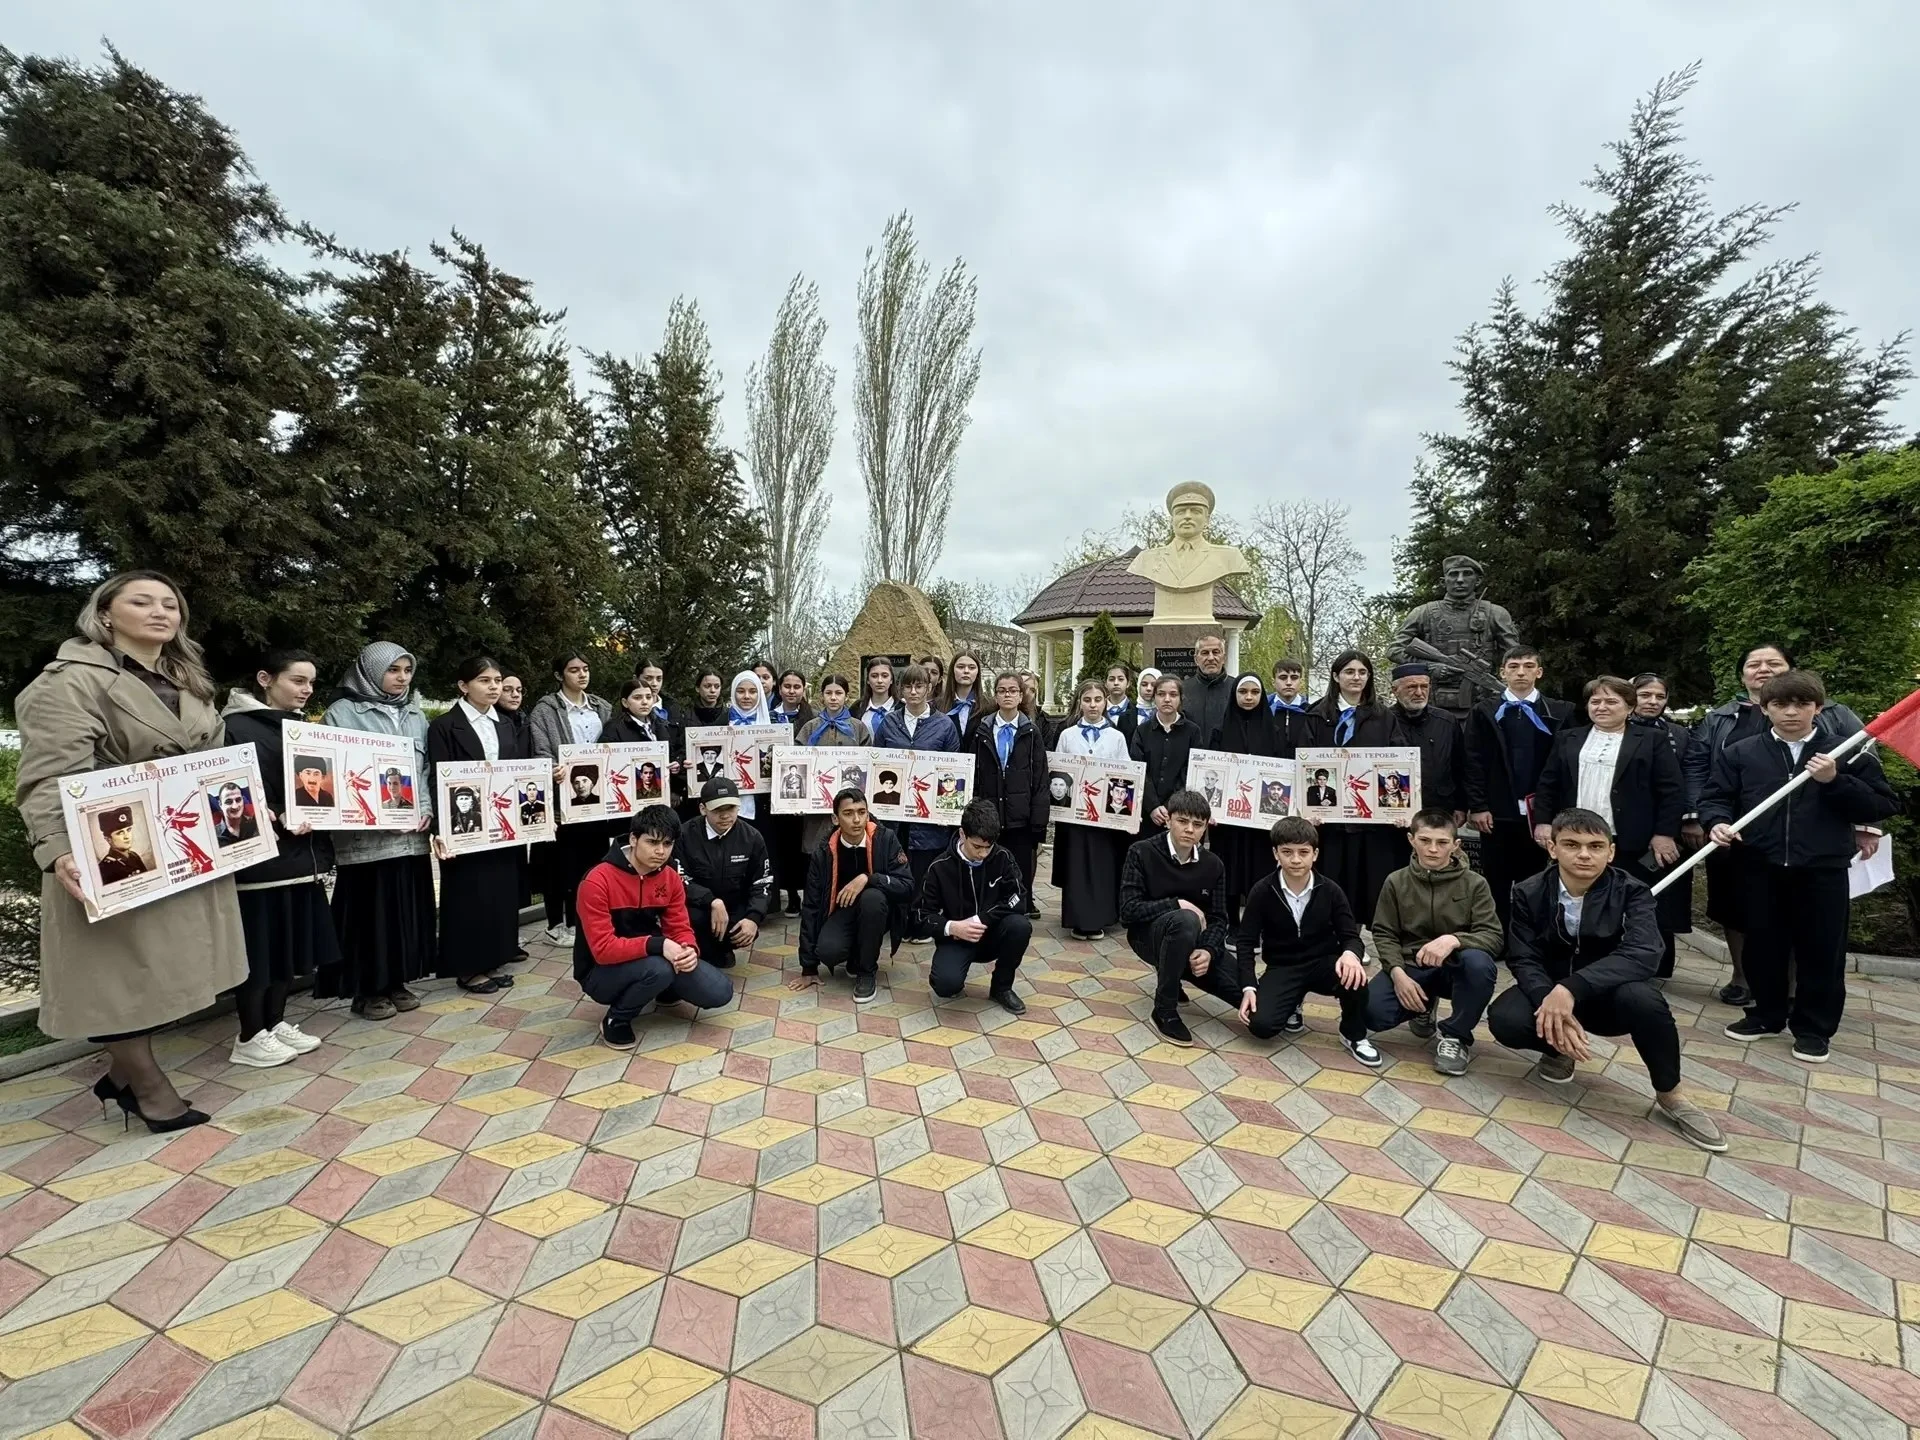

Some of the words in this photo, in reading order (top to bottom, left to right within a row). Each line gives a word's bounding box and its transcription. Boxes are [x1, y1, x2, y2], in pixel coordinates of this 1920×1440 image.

[308, 731, 360, 744] «НАСЛЕДИЕ
[361, 736, 396, 748] ГЕРОЕВ»
[102, 765, 178, 788] «НАСЛЕДИЕ
[184, 756, 230, 772] ГЕРОЕВ»
[1228, 798, 1242, 812] 80
